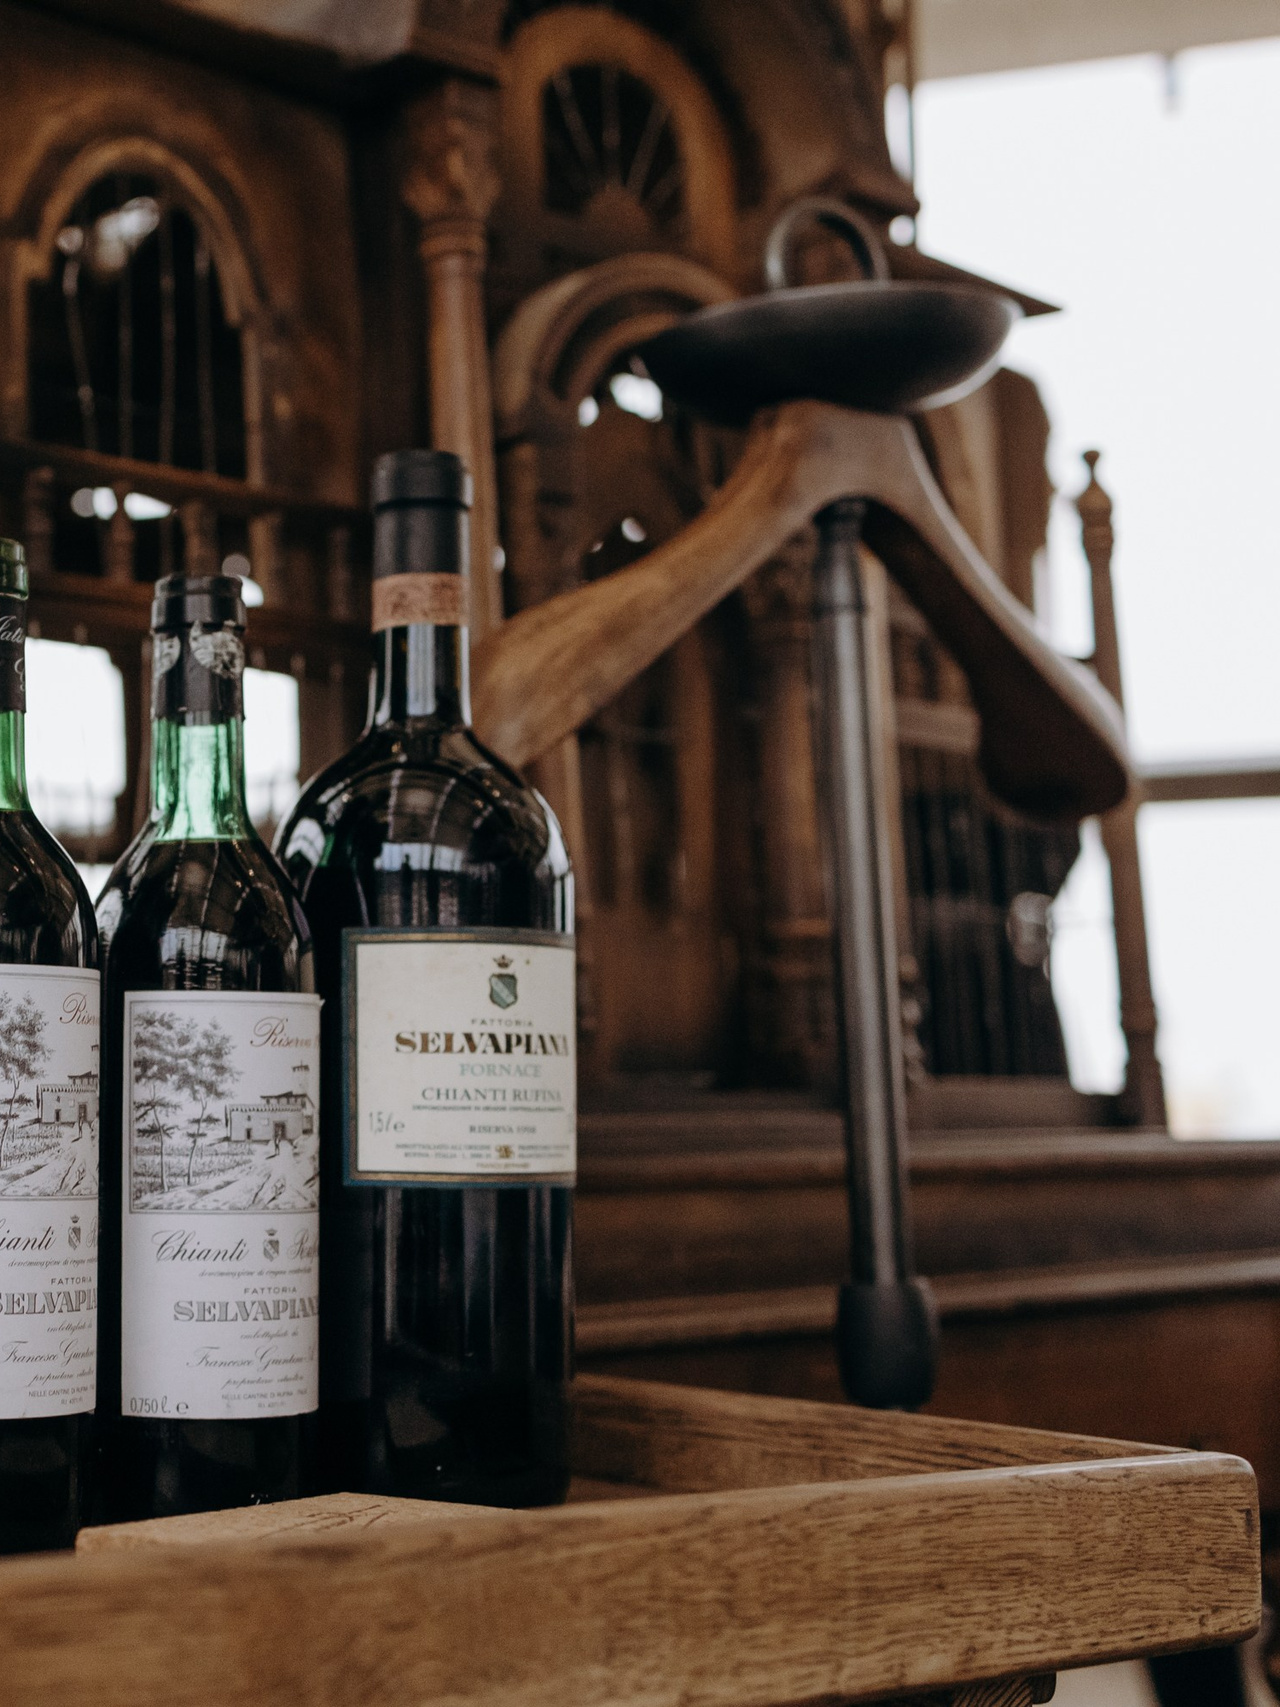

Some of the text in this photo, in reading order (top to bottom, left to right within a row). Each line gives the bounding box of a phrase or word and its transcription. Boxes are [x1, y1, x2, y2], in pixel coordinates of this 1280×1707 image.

[471, 1018, 533, 1027] FATTORIA
[459, 1064, 542, 1078] FORNACE
[422, 1087, 507, 1101] CHIANTI
[151, 1229, 249, 1262] Chianti
[51, 1276, 92, 1285] FATTORIA
[244, 1287, 297, 1295] FATTORIA
